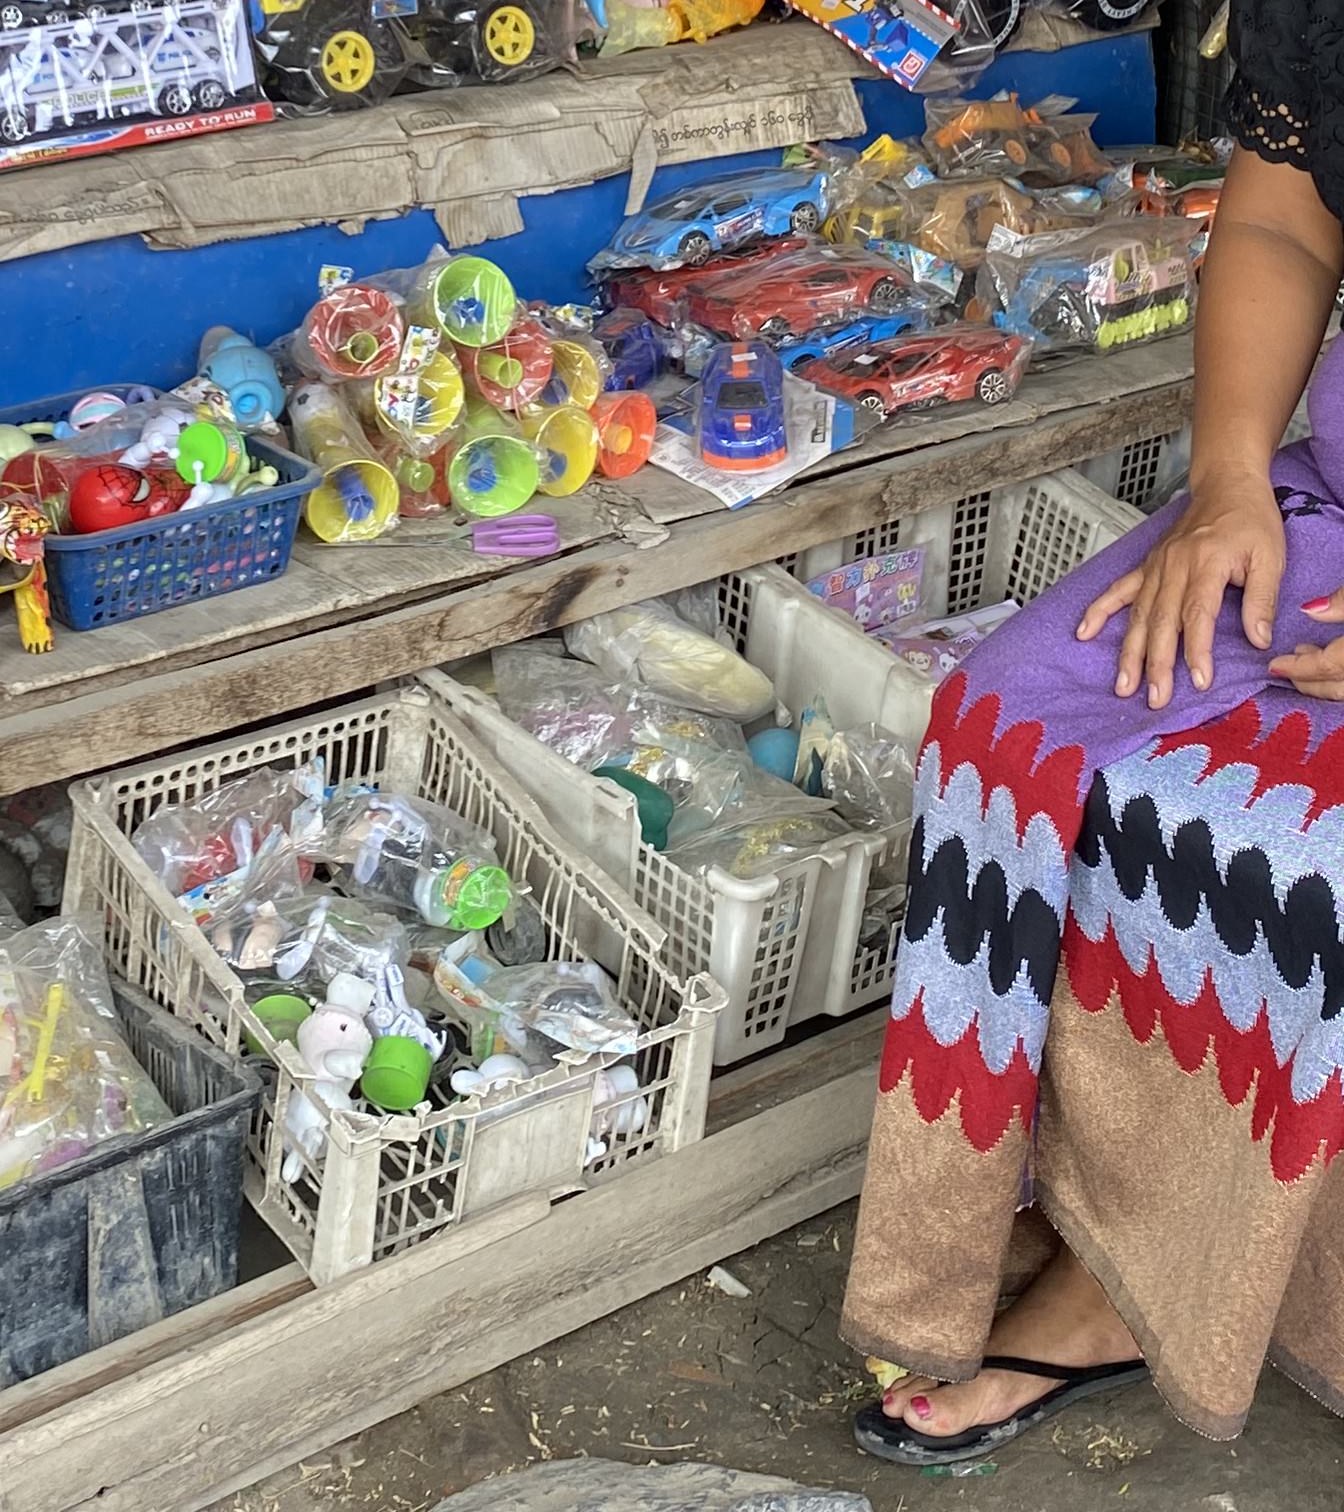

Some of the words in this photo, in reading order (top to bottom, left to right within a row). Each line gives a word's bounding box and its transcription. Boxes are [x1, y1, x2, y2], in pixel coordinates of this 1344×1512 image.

[144, 120, 198, 137] READY
[200, 115, 223, 127] TO
[224, 108, 257, 124] RUN
